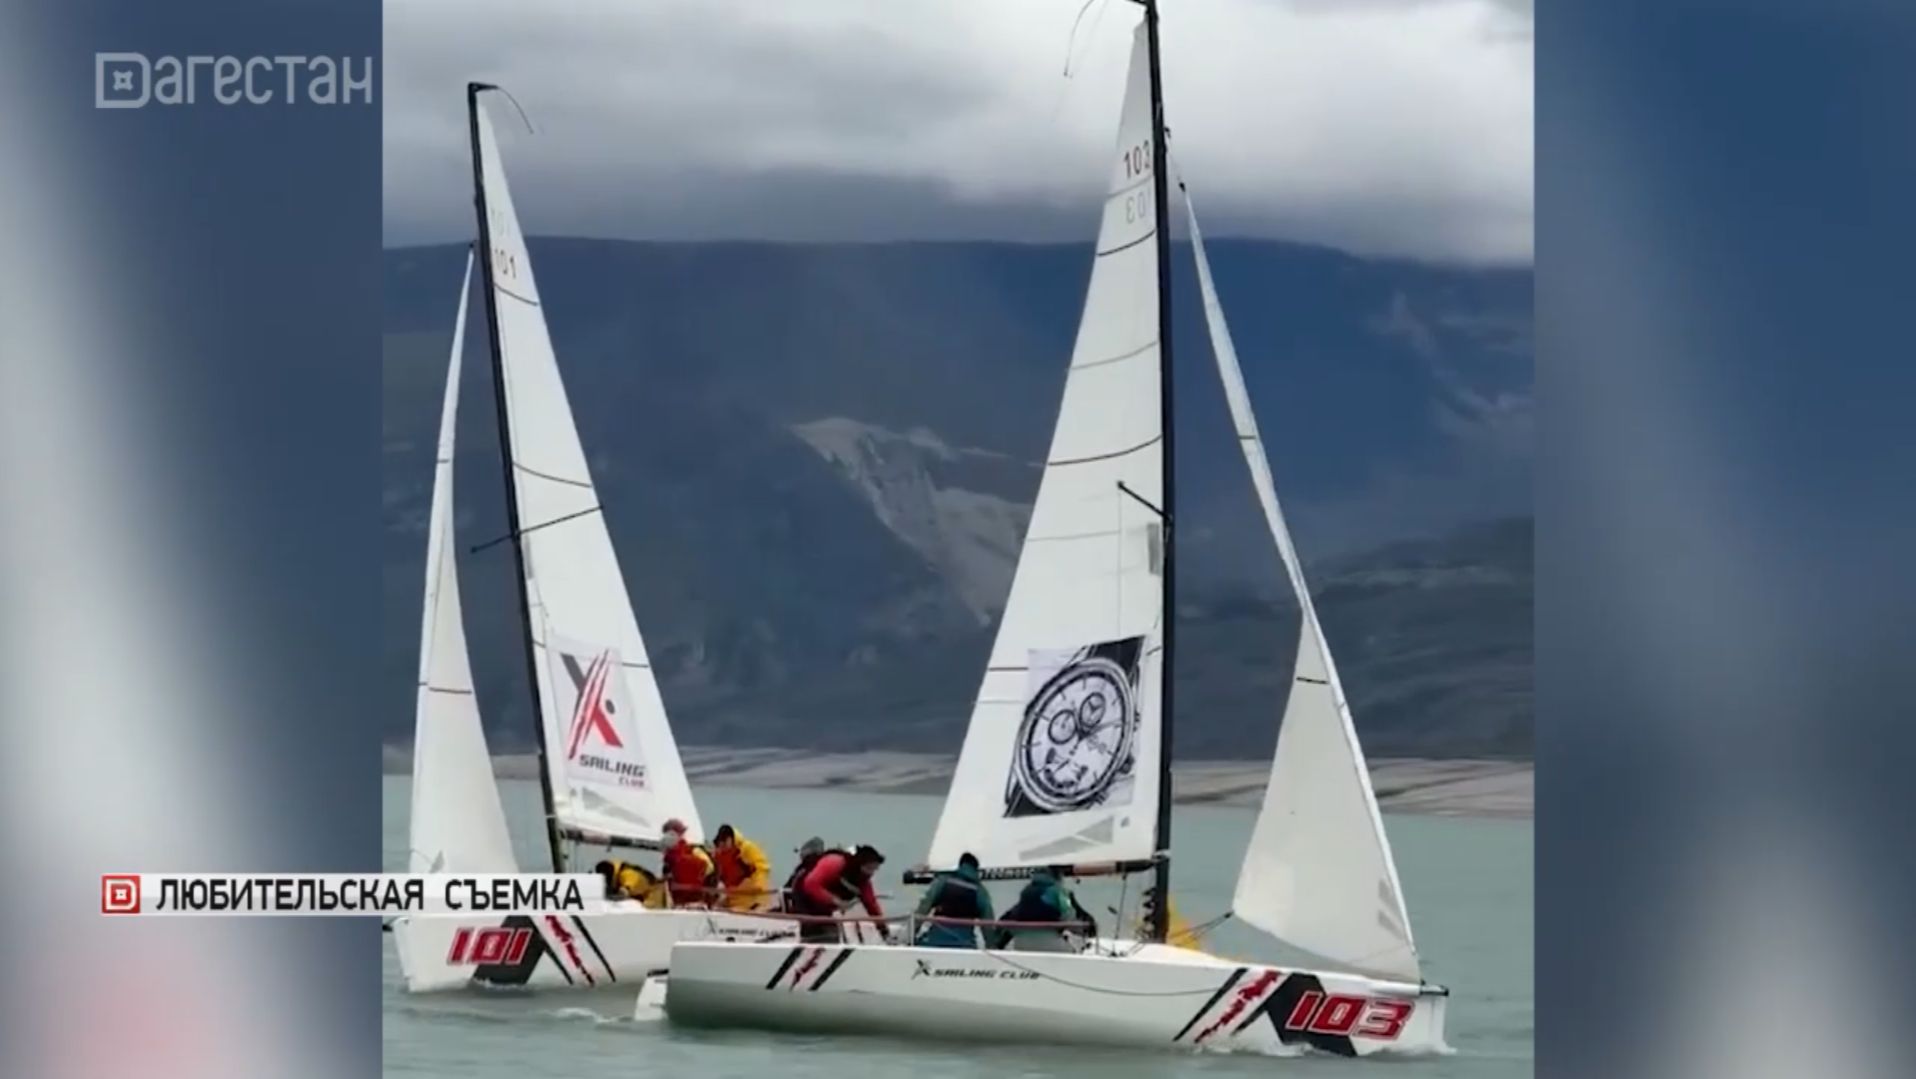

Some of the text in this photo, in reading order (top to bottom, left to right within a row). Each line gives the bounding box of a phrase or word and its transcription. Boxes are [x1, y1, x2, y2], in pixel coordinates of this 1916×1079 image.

[579, 754, 645, 777] SAILING
[618, 777, 645, 788] CLUB
[446, 928, 532, 966] 101
[934, 969, 997, 978] SAILING
[1000, 970, 1040, 980] CLUB
[1286, 991, 1416, 1040] 103
